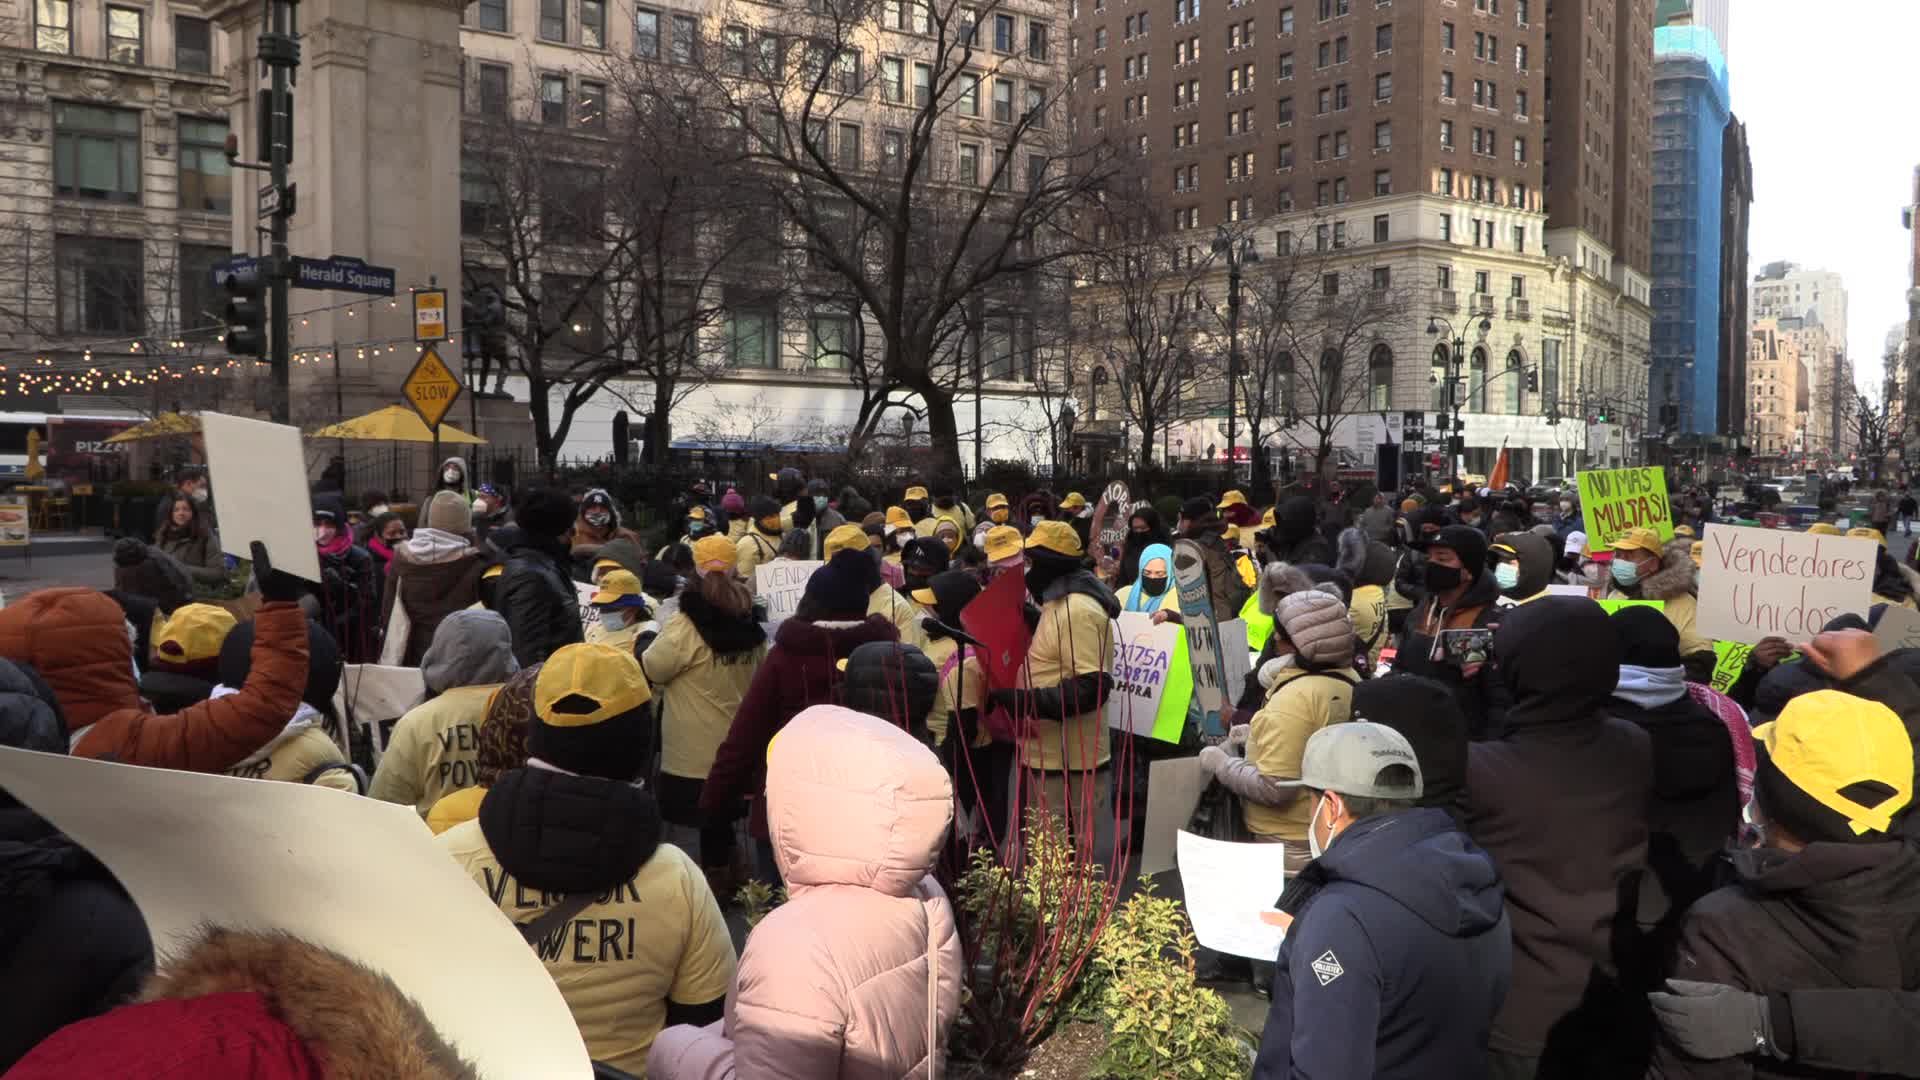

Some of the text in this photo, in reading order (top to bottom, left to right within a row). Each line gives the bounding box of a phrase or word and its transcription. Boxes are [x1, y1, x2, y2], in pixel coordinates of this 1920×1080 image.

[300, 263, 344, 284] Herald
[347, 270, 391, 289] Square
[415, 385, 449, 401] SLOW
[1587, 467, 1653, 500] NO MAS
[1593, 493, 1668, 537] MULTAS!
[1713, 532, 1865, 581] Vendedores
[1111, 680, 1152, 699] HORA
